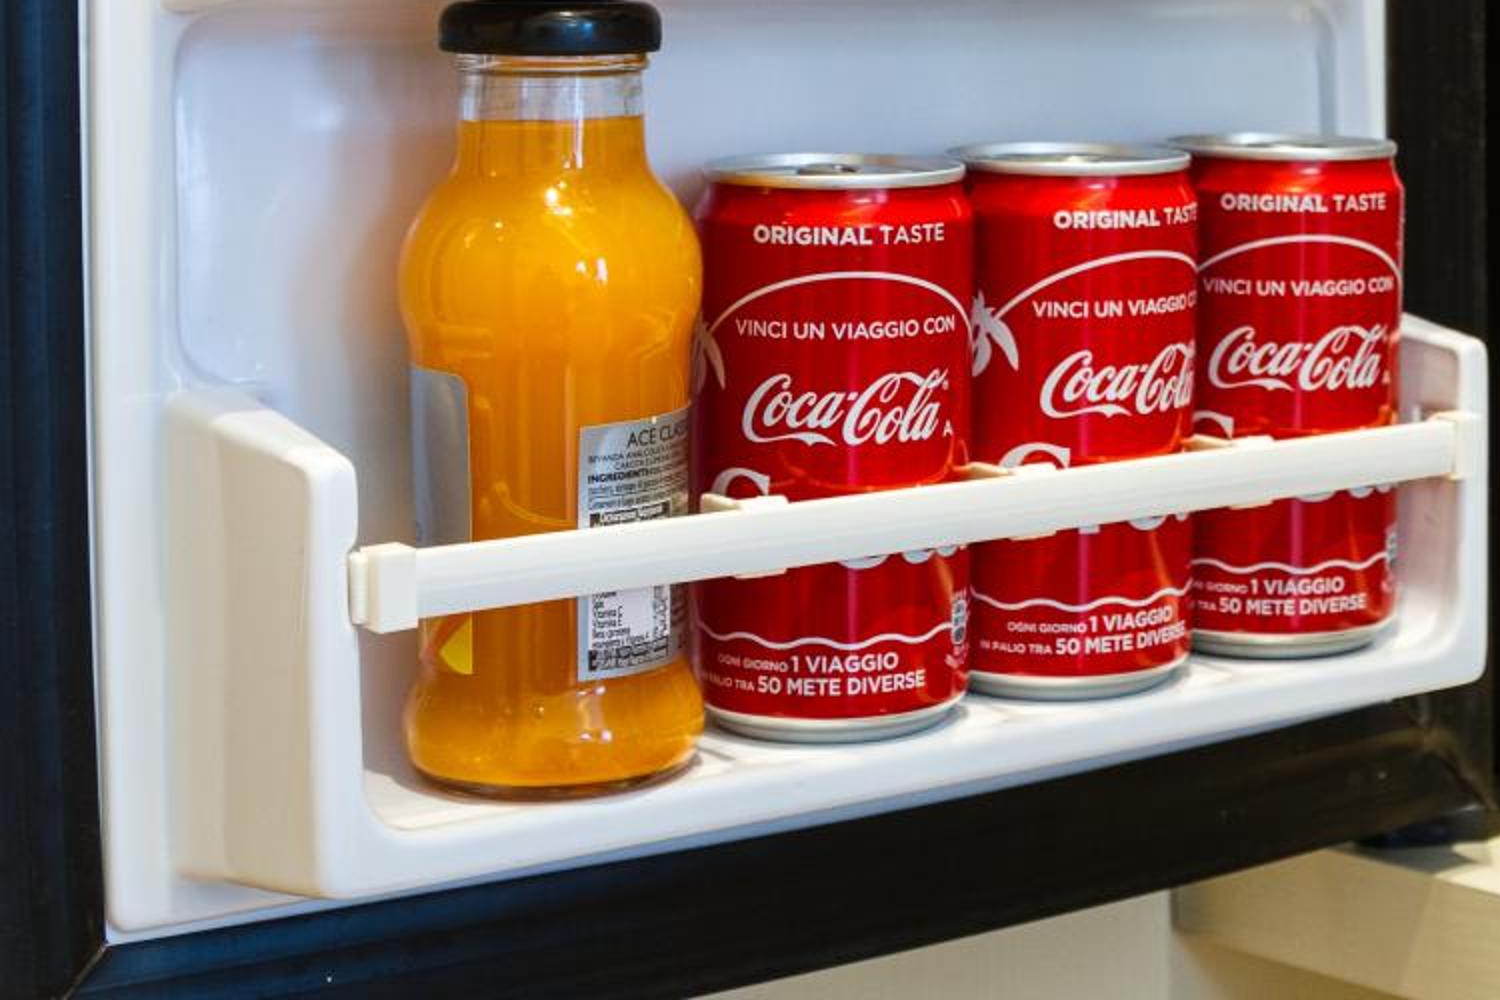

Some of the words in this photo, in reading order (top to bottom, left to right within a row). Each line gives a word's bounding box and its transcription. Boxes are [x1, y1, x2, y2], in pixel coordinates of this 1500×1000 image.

[1220, 192, 1328, 213] ORIGINAL
[1333, 192, 1387, 212] TASTE
[1054, 209, 1160, 230] ORIGINAL
[753, 223, 873, 246] ORIGINAL
[879, 222, 945, 245] TASTE
[1203, 278, 1251, 296] VINCI
[1256, 281, 1286, 297] UN
[1291, 278, 1365, 297] VIAGGIO
[1368, 277, 1394, 294] CON
[1033, 300, 1088, 319] VINCI
[1094, 299, 1124, 318] UN
[1128, 294, 1187, 317] VIAGGIO
[736, 318, 787, 339] VINCI
[793, 322, 826, 340] UN
[832, 319, 919, 340] VIAGGIO
[923, 315, 955, 336] CON
[1208, 324, 1388, 392] Coca-Cola
[742, 369, 948, 447] Coca-Cola
[627, 427, 657, 449] ACE
[1251, 578, 1259, 595] 1
[1263, 576, 1345, 596] VIAGGIO
[1219, 597, 1242, 614] 50
[1245, 599, 1296, 616] METE
[1299, 592, 1368, 615] DIVERSE
[1007, 620, 1037, 634] OGNI
[1039, 623, 1087, 634] GIORNO
[1089, 616, 1097, 633] 1
[1103, 604, 1174, 632] VIAGGIO
[1028, 644, 1053, 656] TRA
[1055, 638, 1081, 656] 50
[1085, 634, 1133, 654] METE
[1137, 619, 1186, 650] DIVERSE
[743, 656, 788, 674] GIORNO
[791, 655, 799, 674] 1
[805, 651, 899, 674] VIAGGIO
[735, 678, 755, 692] TRA
[757, 675, 781, 695] 50
[786, 676, 842, 696] METE
[847, 668, 926, 696] DIVERSE
